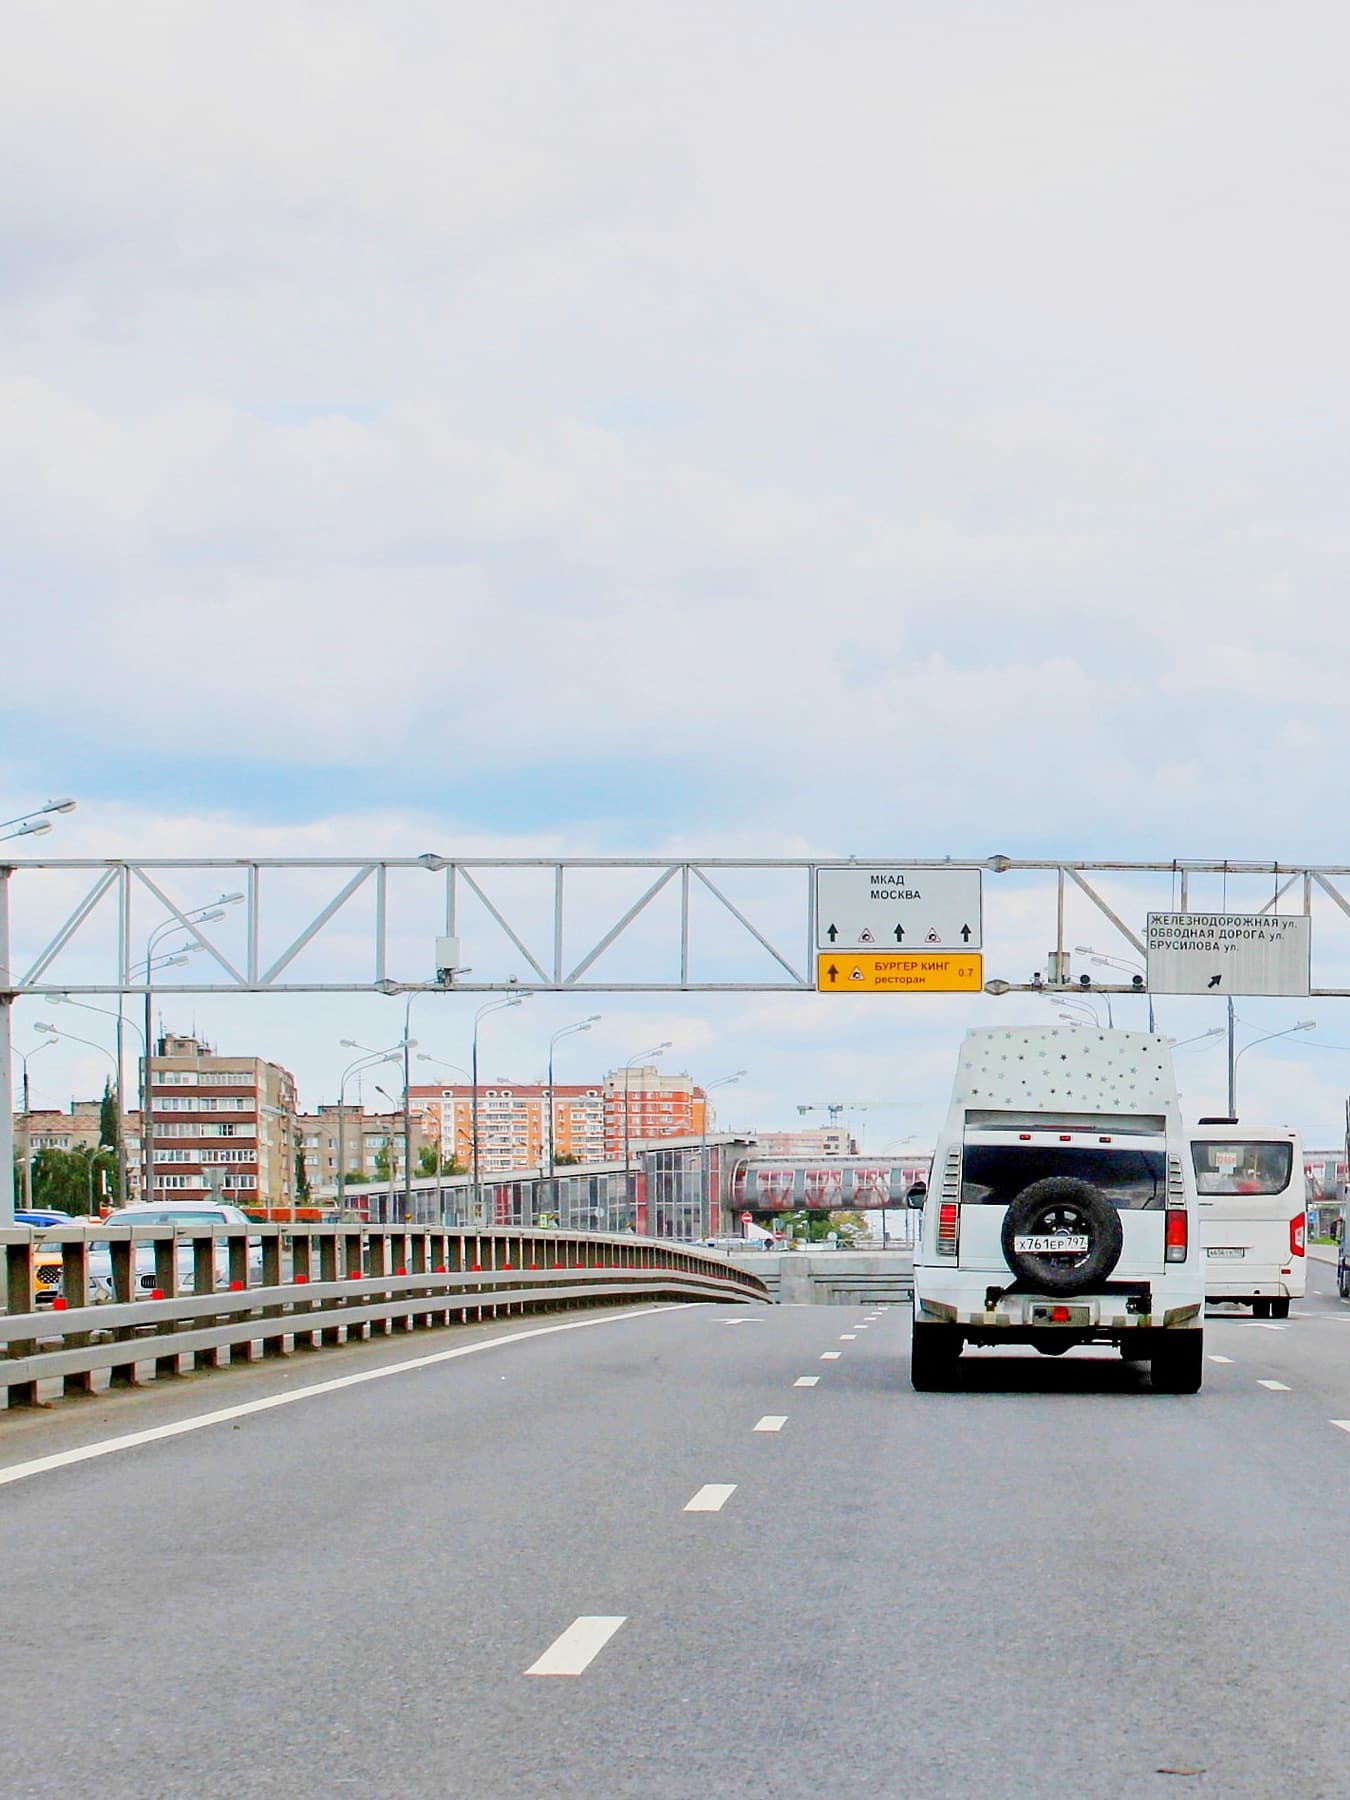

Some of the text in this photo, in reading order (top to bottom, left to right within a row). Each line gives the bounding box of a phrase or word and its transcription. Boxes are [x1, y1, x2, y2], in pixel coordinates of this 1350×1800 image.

[870, 875, 905, 886] МКАД
[870, 890, 921, 900] МОСКВА
[1151, 915, 1297, 929] ЖЕЛЕЗНОДОРОЖНАЯ ул.
[1150, 928, 1285, 942] ОБВОДНАЯ ДОРОГА ул.
[1150, 941, 1239, 953] БРУСИЛОВА ул.
[874, 961, 951, 972] БУРГЕР КИНГ
[874, 976, 926, 985] ресторан
